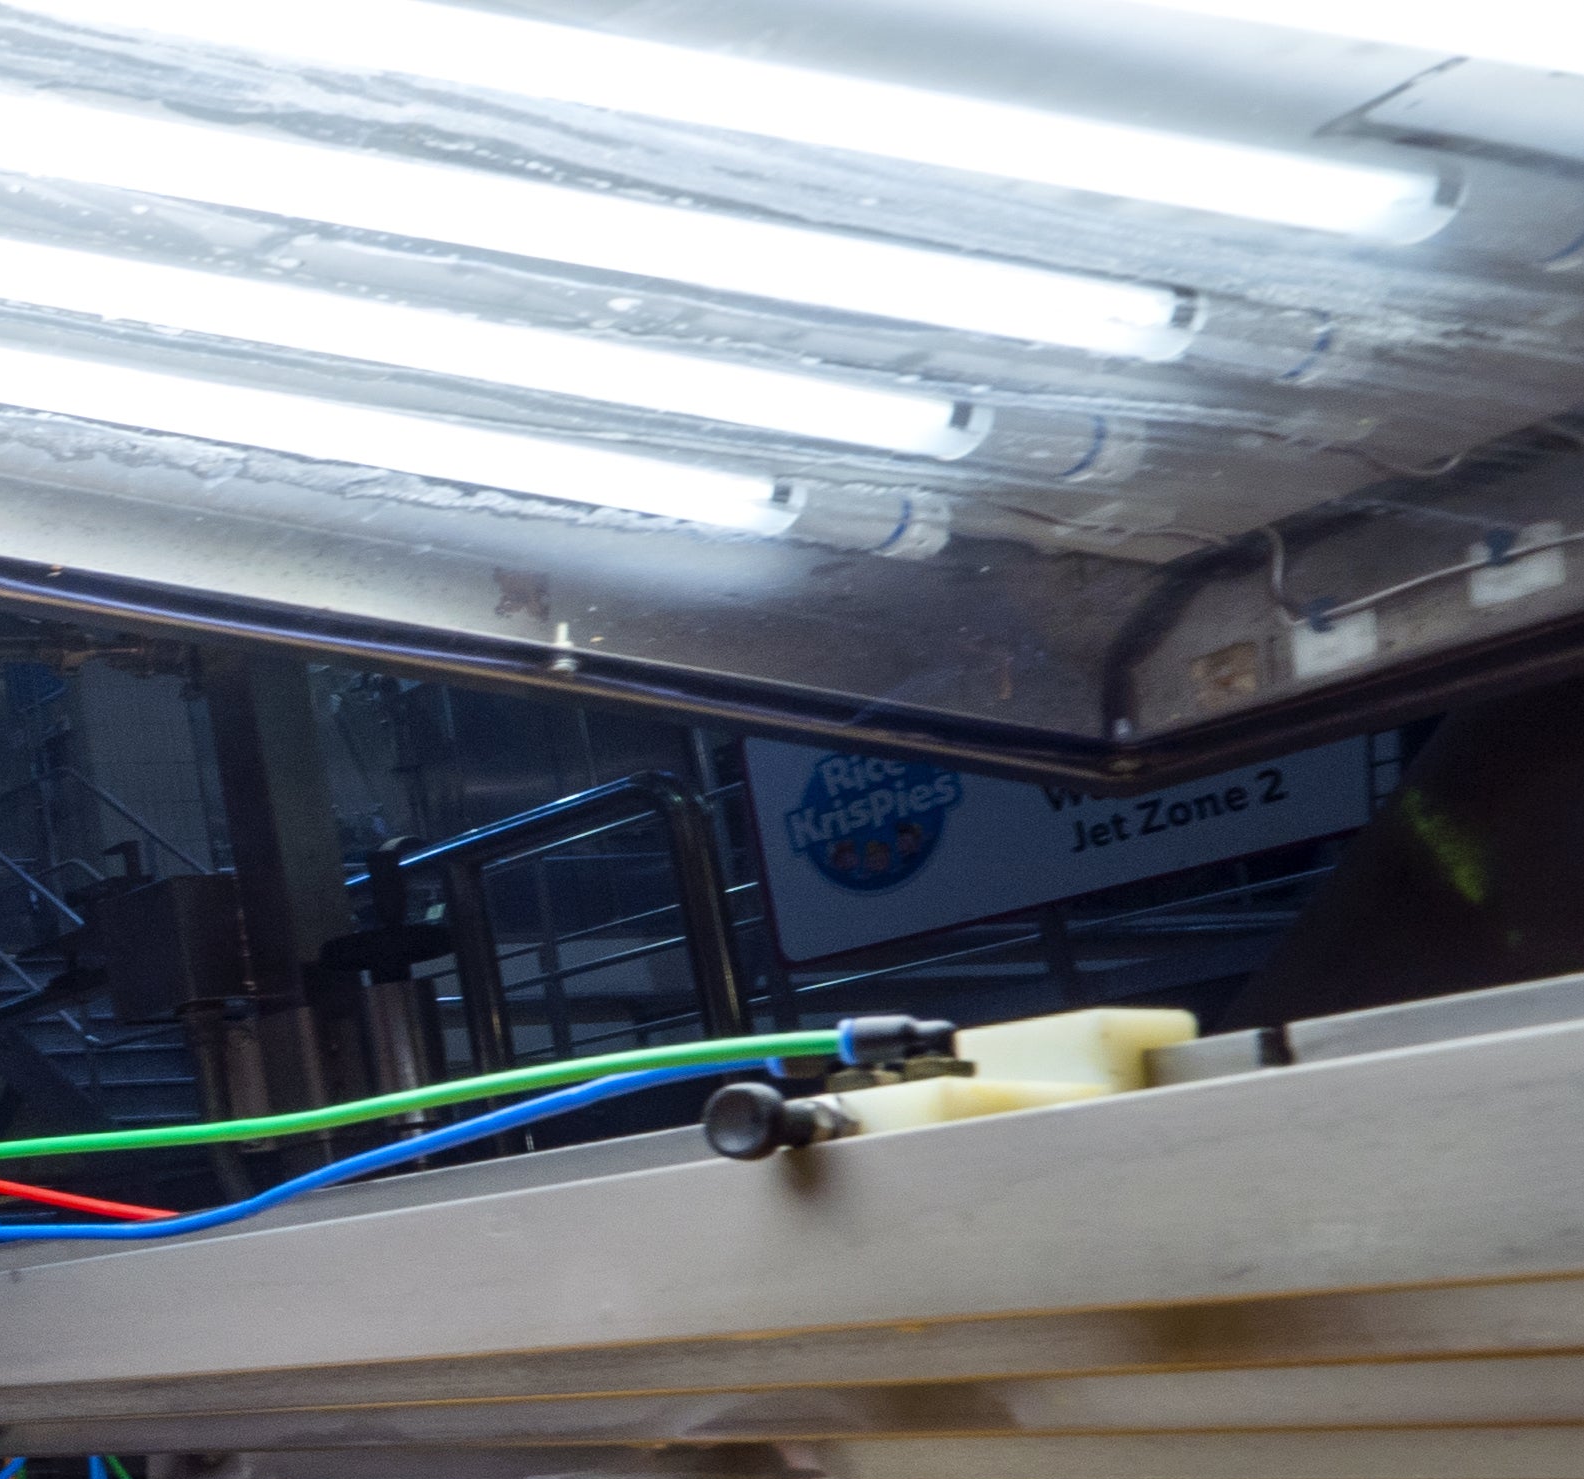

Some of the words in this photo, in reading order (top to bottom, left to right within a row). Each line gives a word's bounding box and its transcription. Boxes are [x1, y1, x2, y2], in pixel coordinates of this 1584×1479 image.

[1072, 814, 1131, 853] Jet
[1134, 786, 1249, 836] Zone
[1255, 767, 1289, 804] 2
